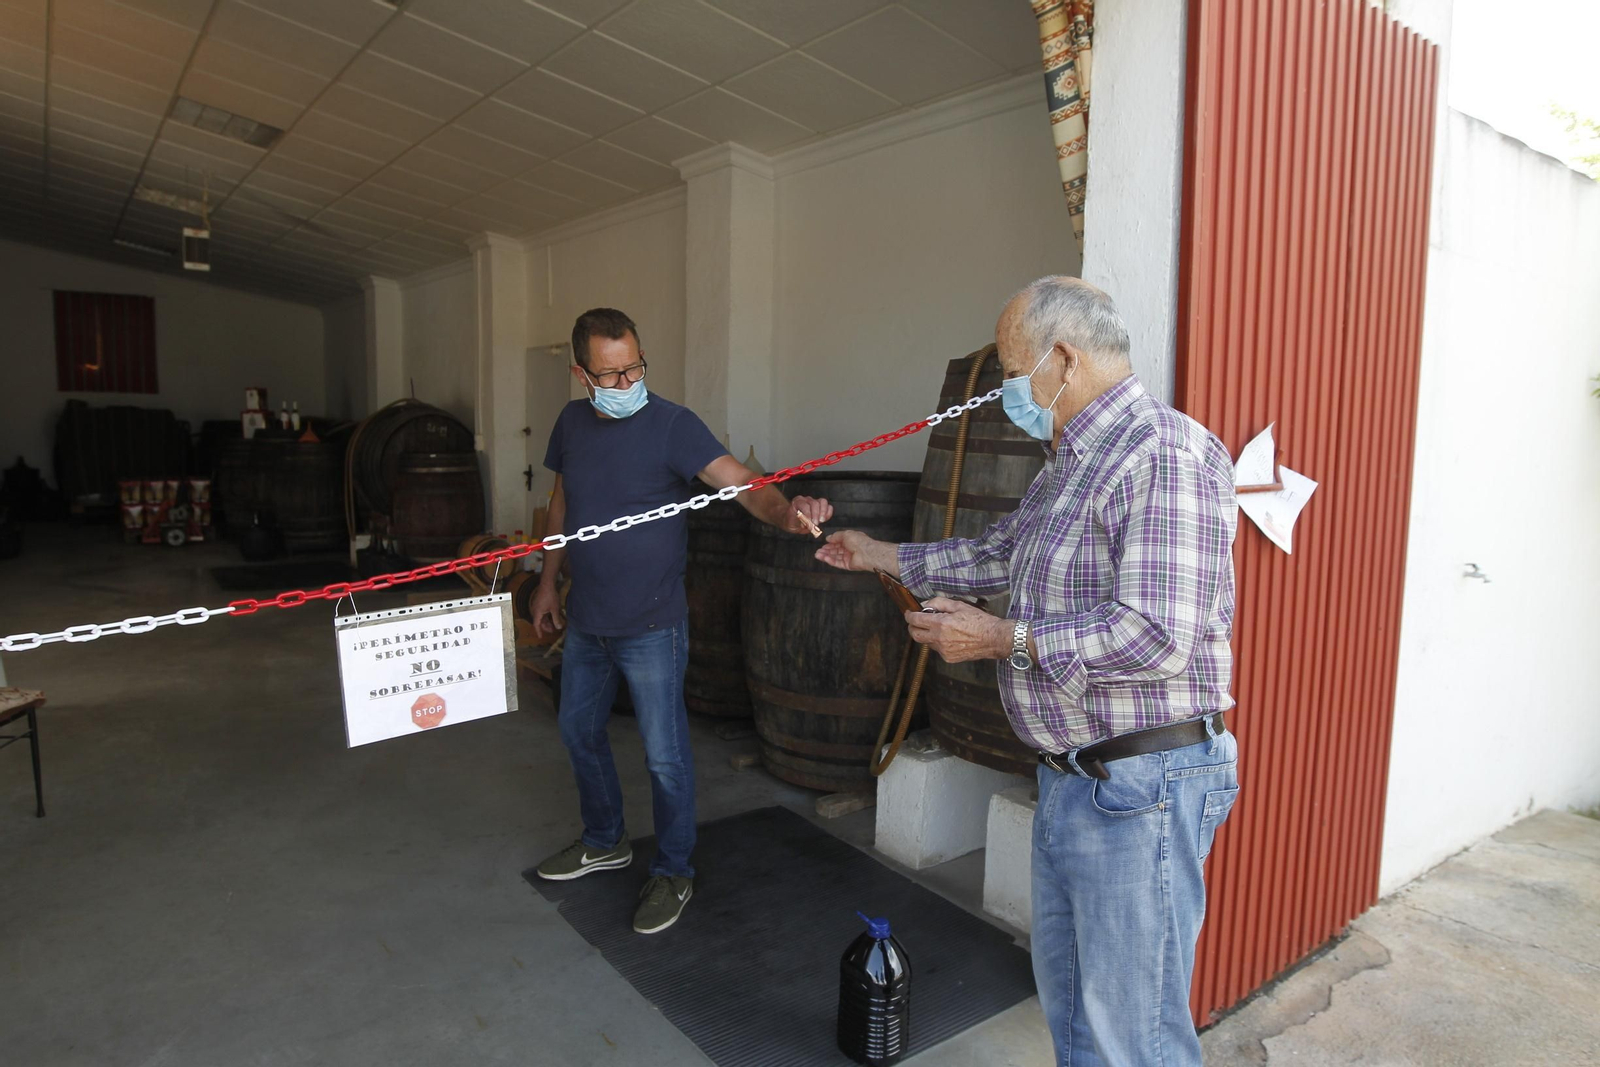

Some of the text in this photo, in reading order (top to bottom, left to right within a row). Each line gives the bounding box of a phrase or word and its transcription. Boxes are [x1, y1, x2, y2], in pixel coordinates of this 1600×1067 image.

[353, 621, 489, 651] ¡PERÍMETRO DE
[375, 637, 471, 662] SEGURIDAD
[410, 659, 441, 675] NO
[369, 669, 482, 699] SOBREPASAR!
[415, 705, 443, 718] STOP
